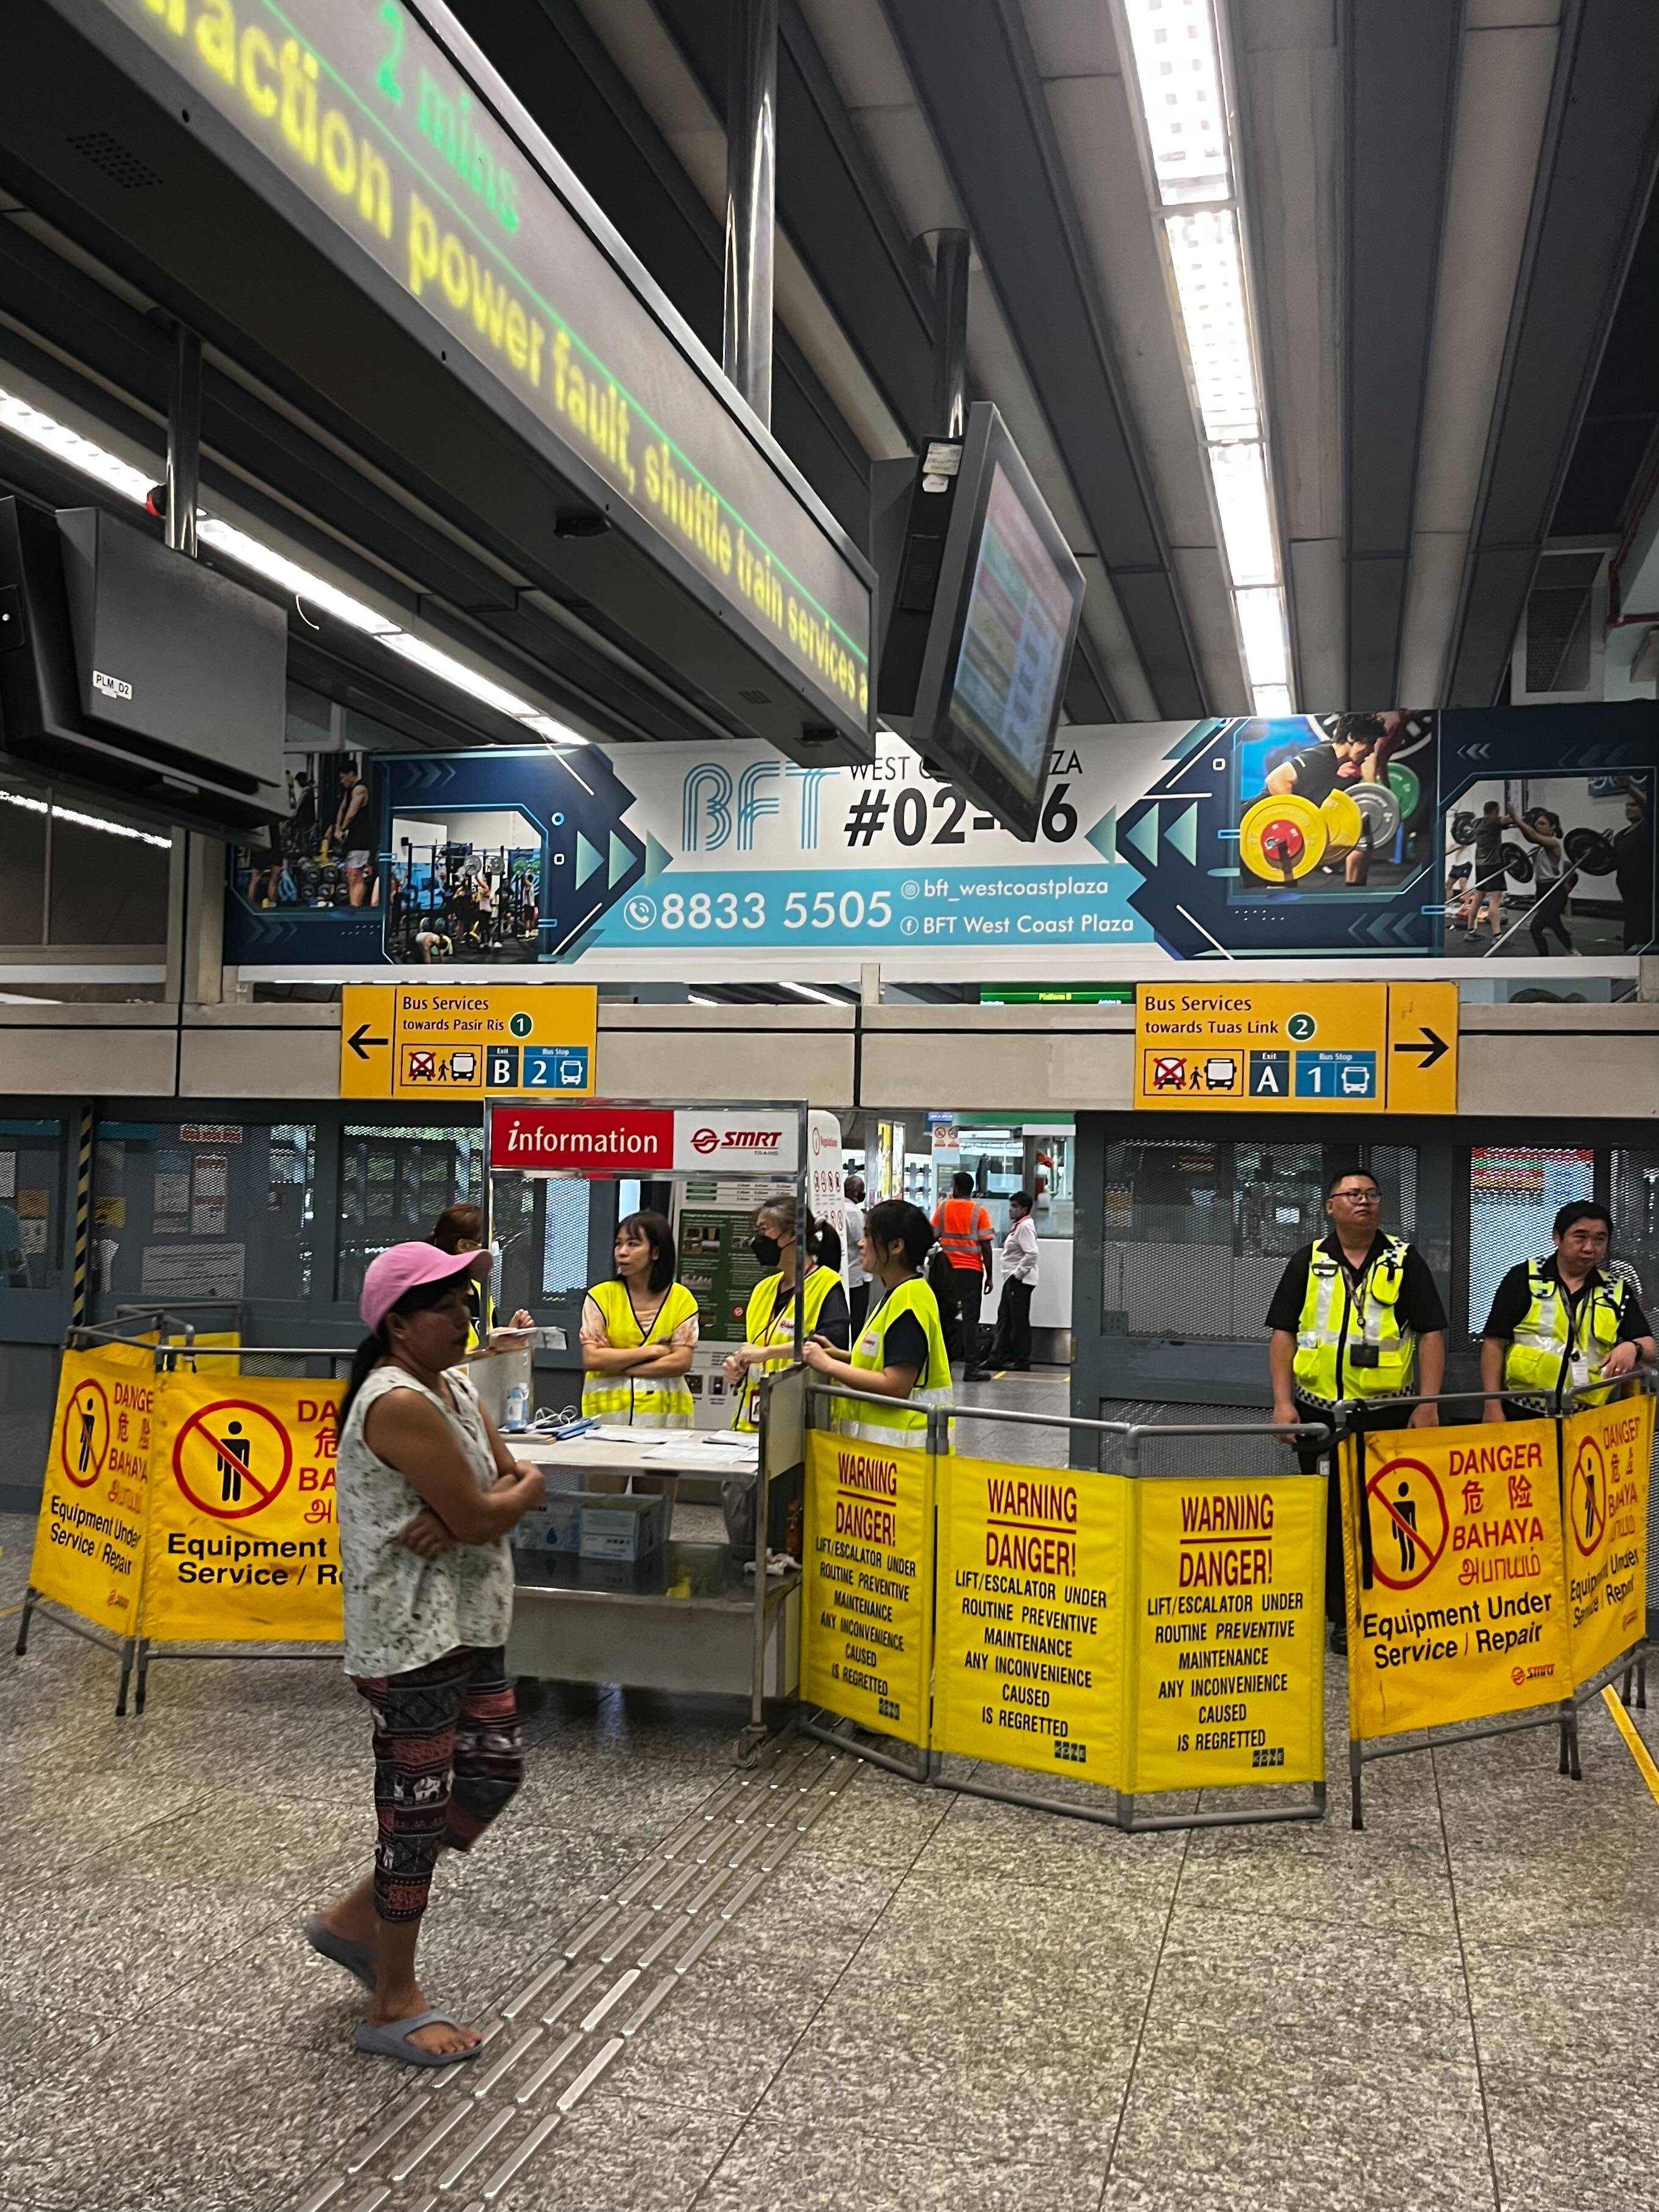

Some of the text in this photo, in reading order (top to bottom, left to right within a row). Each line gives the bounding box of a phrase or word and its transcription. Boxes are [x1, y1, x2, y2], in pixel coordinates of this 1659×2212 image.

[377, 1, 520, 235] 2 mins
[142, 0, 394, 240] action
[408, 190, 545, 387] power
[553, 330, 636, 494] fault,
[644, 441, 732, 575] shuttle
[736, 527, 783, 629] train
[787, 595, 856, 700] services
[850, 756, 910, 781] WEST
[682, 761, 841, 852] BFT
[844, 783, 1078, 847] #02-6
[924, 876, 1108, 901] bft_westcoastplaza
[661, 890, 892, 929] 8833 5505
[923, 915, 1134, 934] BFT West Coast Plaza
[402, 995, 489, 1011] Bus Services
[1145, 995, 1252, 1011] Bus Services
[402, 1017, 504, 1031] towards Pasir Ris
[516, 1017, 524, 1032] 1
[1145, 1020, 1279, 1034] towards Tuas Link
[1295, 1019, 1308, 1035] 2
[542, 1047, 569, 1056] Bus Stop
[1334, 1052, 1353, 1061] Stop
[494, 1060, 510, 1083] B
[531, 1060, 547, 1084] 2
[1257, 1066, 1279, 1093] A
[1307, 1066, 1321, 1093] 1
[508, 1120, 658, 1154] information
[721, 1131, 783, 1147] SMRT
[114, 1382, 154, 1414] DANGE
[837, 1451, 897, 1496] WARNING
[1448, 1442, 1543, 1477] DANGER
[987, 1478, 1077, 1522] WARNING
[1181, 1493, 1274, 1532] WARNING
[51, 1494, 113, 1536] Equipment
[114, 1516, 142, 1550] Under
[836, 1501, 896, 1546] DANGER!
[1452, 1516, 1544, 1551] BAHAYA
[50, 1522, 95, 1557] Service
[102, 1541, 133, 1576] Repair
[167, 1533, 327, 1565] Equipment
[816, 1535, 916, 1577] LIFT/ESCALATOR UNDER
[986, 1531, 1076, 1577] DANGER!
[177, 1561, 288, 1586] Service
[820, 1561, 910, 1601] ROUTINE PREVENTIVE
[1179, 1548, 1273, 1588] DANGER!
[955, 1569, 1107, 1609] LIFT/ESCALATOR UNDER
[1147, 1592, 1304, 1617] LIFT/ESCALATOR UNDER
[834, 1590, 893, 1623] MAINTENANCE
[962, 1597, 1098, 1635] ROUTINE PREVENTIVE
[1363, 1599, 1481, 1640] Equipment
[1487, 1591, 1553, 1621] Under
[820, 1610, 904, 1651] ANY INCONVENIENCE
[984, 1627, 1073, 1657] MAINTENANCE
[1155, 1620, 1295, 1643] ROUTINE PREVENTIVE
[1374, 1638, 1459, 1670] Service
[1477, 1621, 1543, 1654] Repair
[845, 1643, 877, 1668] CAUSED
[964, 1651, 1092, 1688] ANY INCONVENIENCE
[1179, 1646, 1269, 1670] MAINTENANCE
[831, 1663, 888, 1697] IS REGRETTED
[1002, 1684, 1050, 1708] CAUSED
[1158, 1673, 1288, 1699] ANY INCONVENIENCE
[981, 1706, 1069, 1738] IS REGRETTED
[1198, 1703, 1247, 1724] CAUSED
[1177, 1728, 1266, 1752] IS REGRETTED
